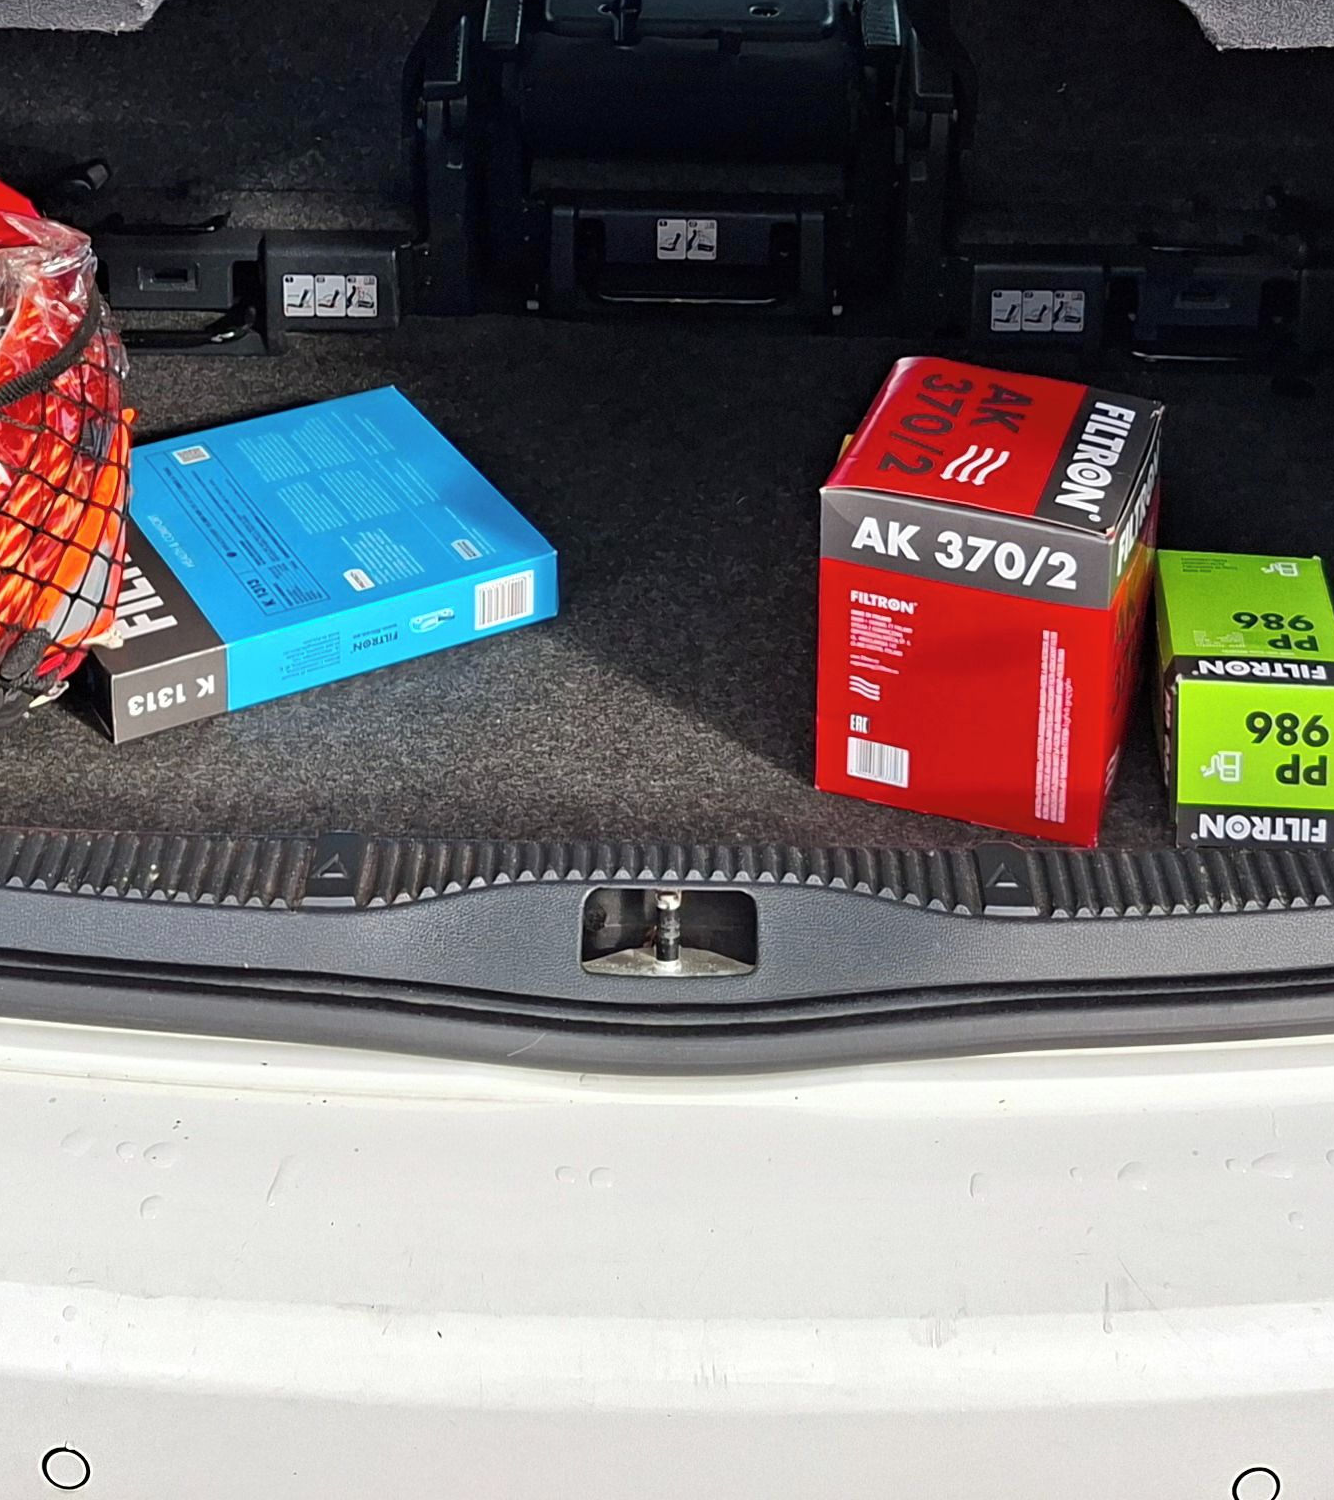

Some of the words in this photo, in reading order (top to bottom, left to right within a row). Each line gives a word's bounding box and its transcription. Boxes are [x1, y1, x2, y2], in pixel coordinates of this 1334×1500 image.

[970, 383, 1034, 434] AK
[877, 373, 974, 476] 370/2
[1054, 401, 1137, 515] FILTRON
[851, 516, 921, 562] AK
[934, 530, 1078, 590] 370/2
[262, 598, 277, 608] K
[850, 589, 915, 615] FILTRON
[1232, 611, 1315, 632] 986
[353, 631, 398, 652] FILTRON
[1267, 633, 1319, 652] PP
[1198, 660, 1327, 680] FILTRON
[127, 683, 186, 716] 1313
[196, 674, 215, 698] K
[1245, 710, 1330, 747] 986
[1275, 753, 1328, 787] PP
[1198, 813, 1327, 843] FILTRON
